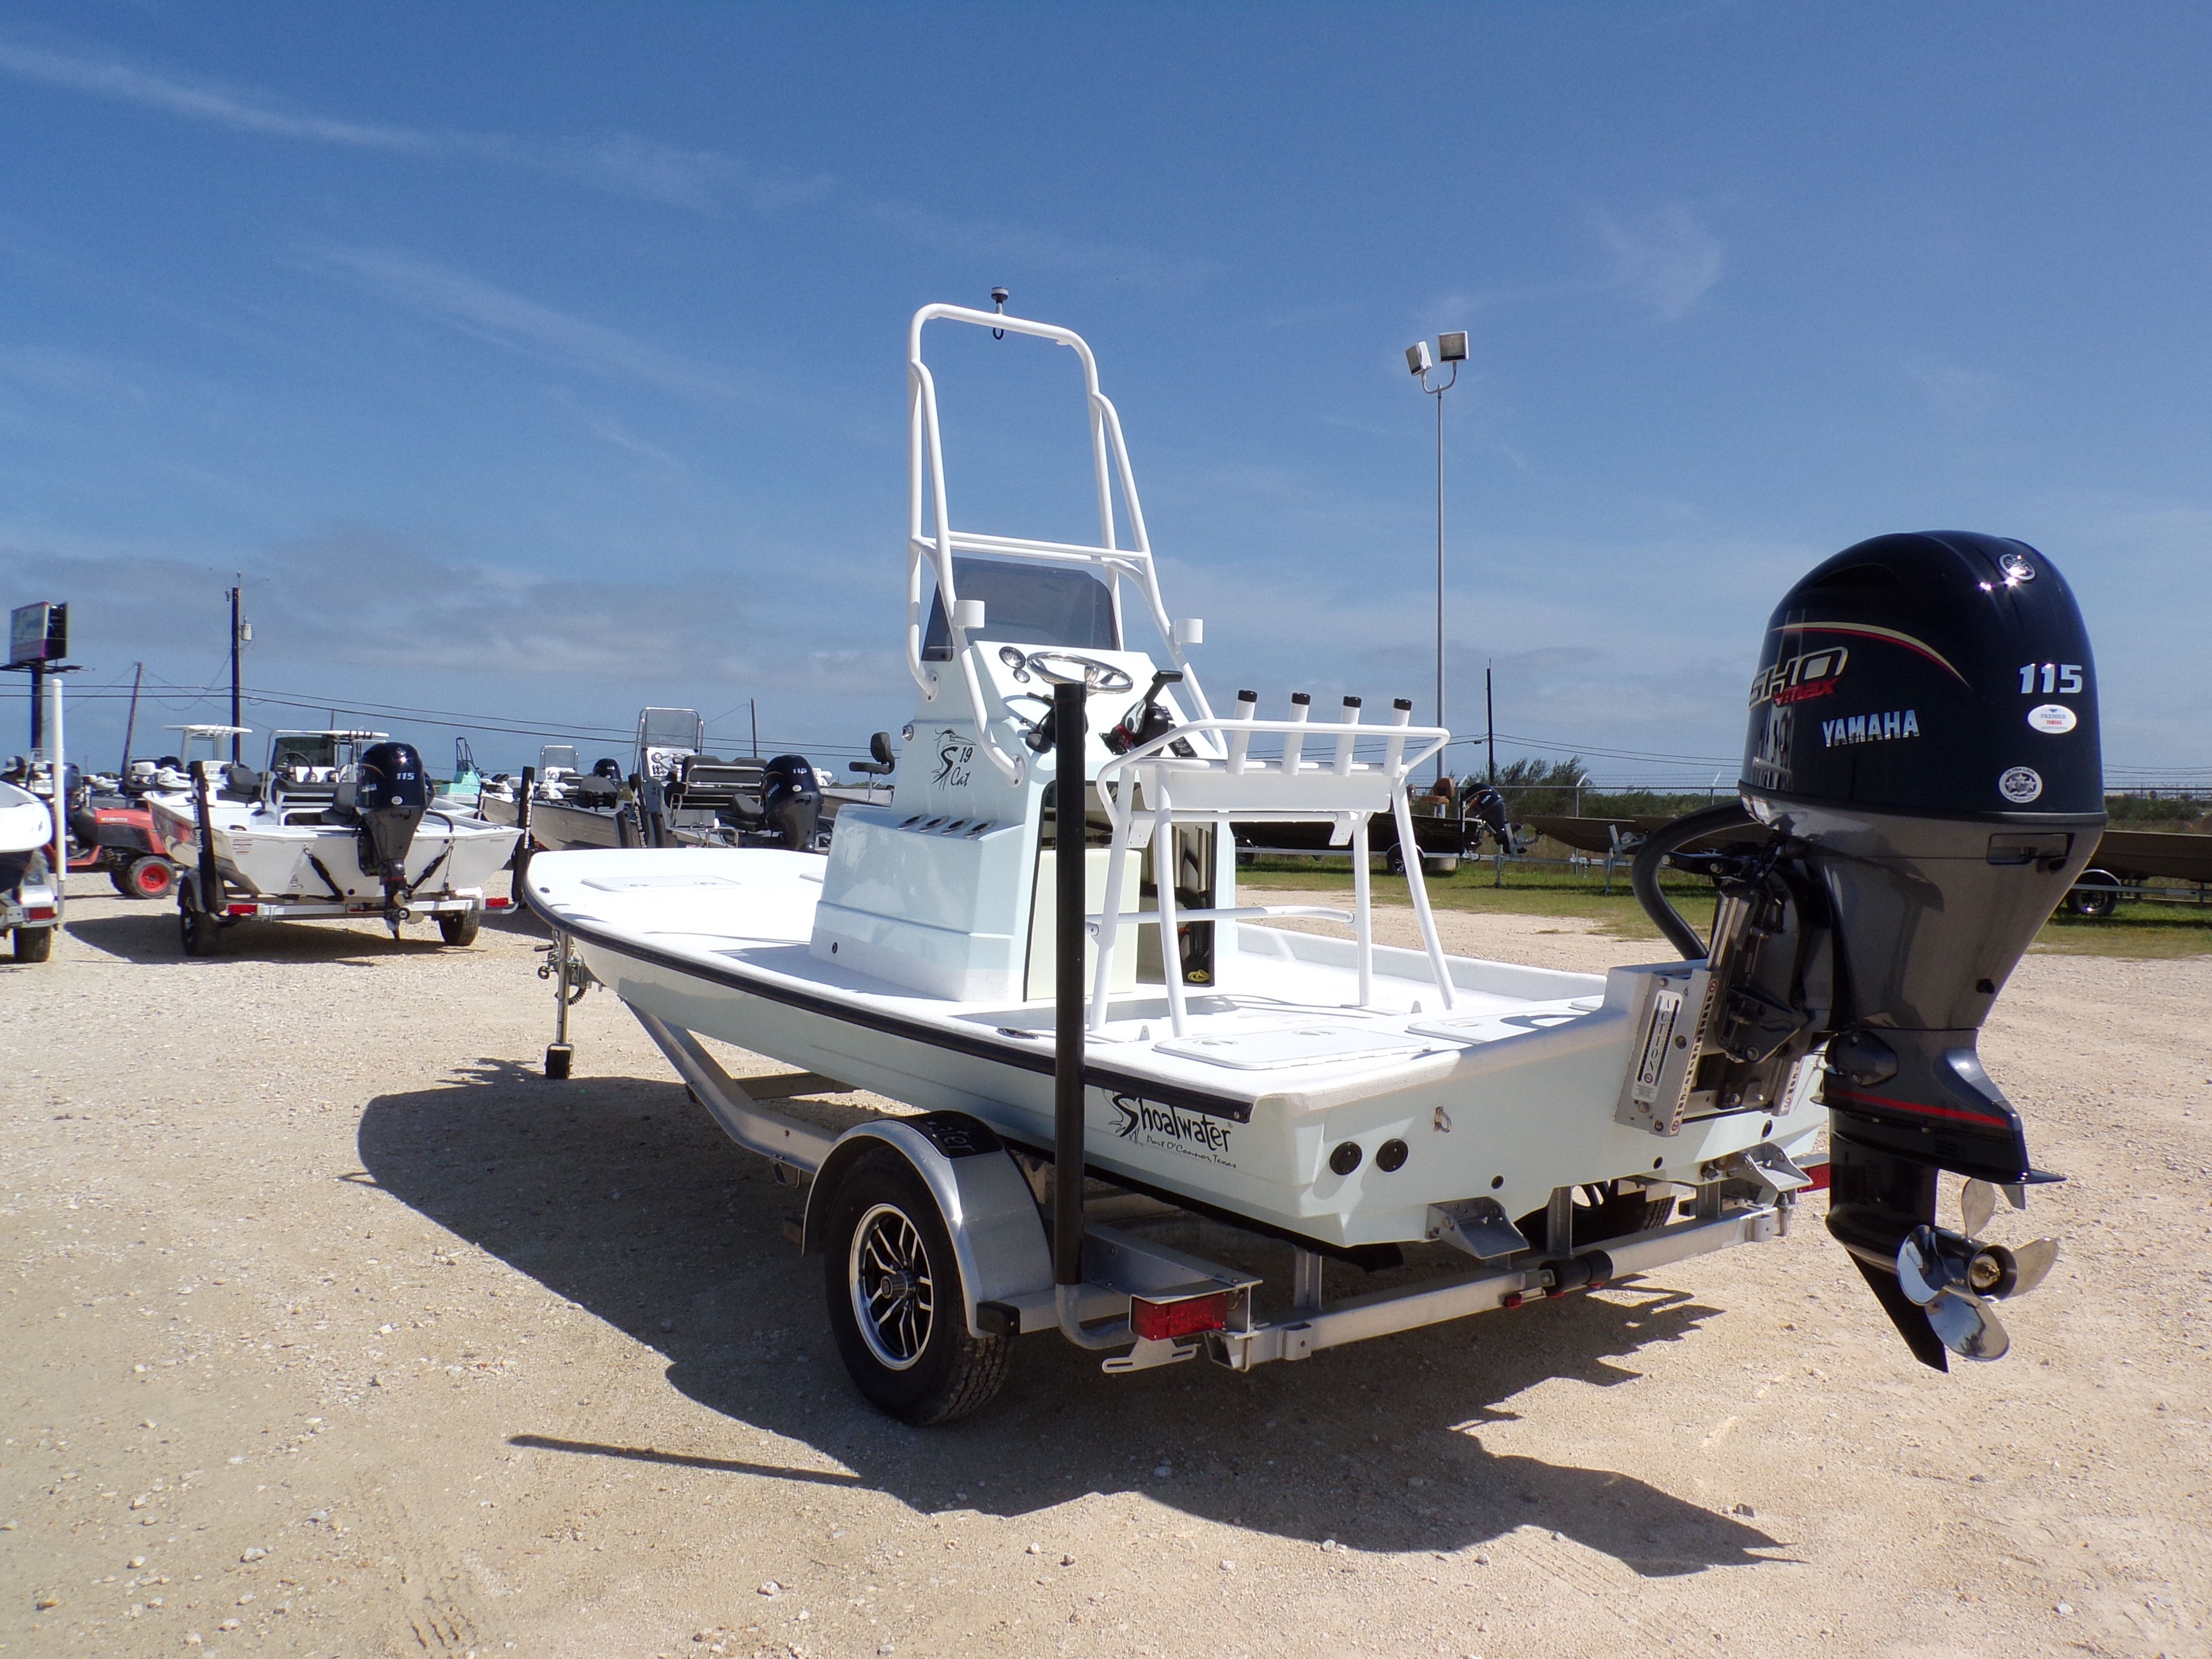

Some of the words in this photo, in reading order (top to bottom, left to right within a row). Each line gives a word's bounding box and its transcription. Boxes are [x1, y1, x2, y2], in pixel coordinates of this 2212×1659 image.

[2020, 663, 2082, 694] 115
[1822, 709, 1920, 747] YAMAHA
[959, 746, 973, 763] 19
[950, 767, 971, 787] Cat
[1112, 1093, 1231, 1153] Shoalwater
[1147, 1135, 1165, 1148] Port
[1213, 1154, 1237, 1168] Texas
